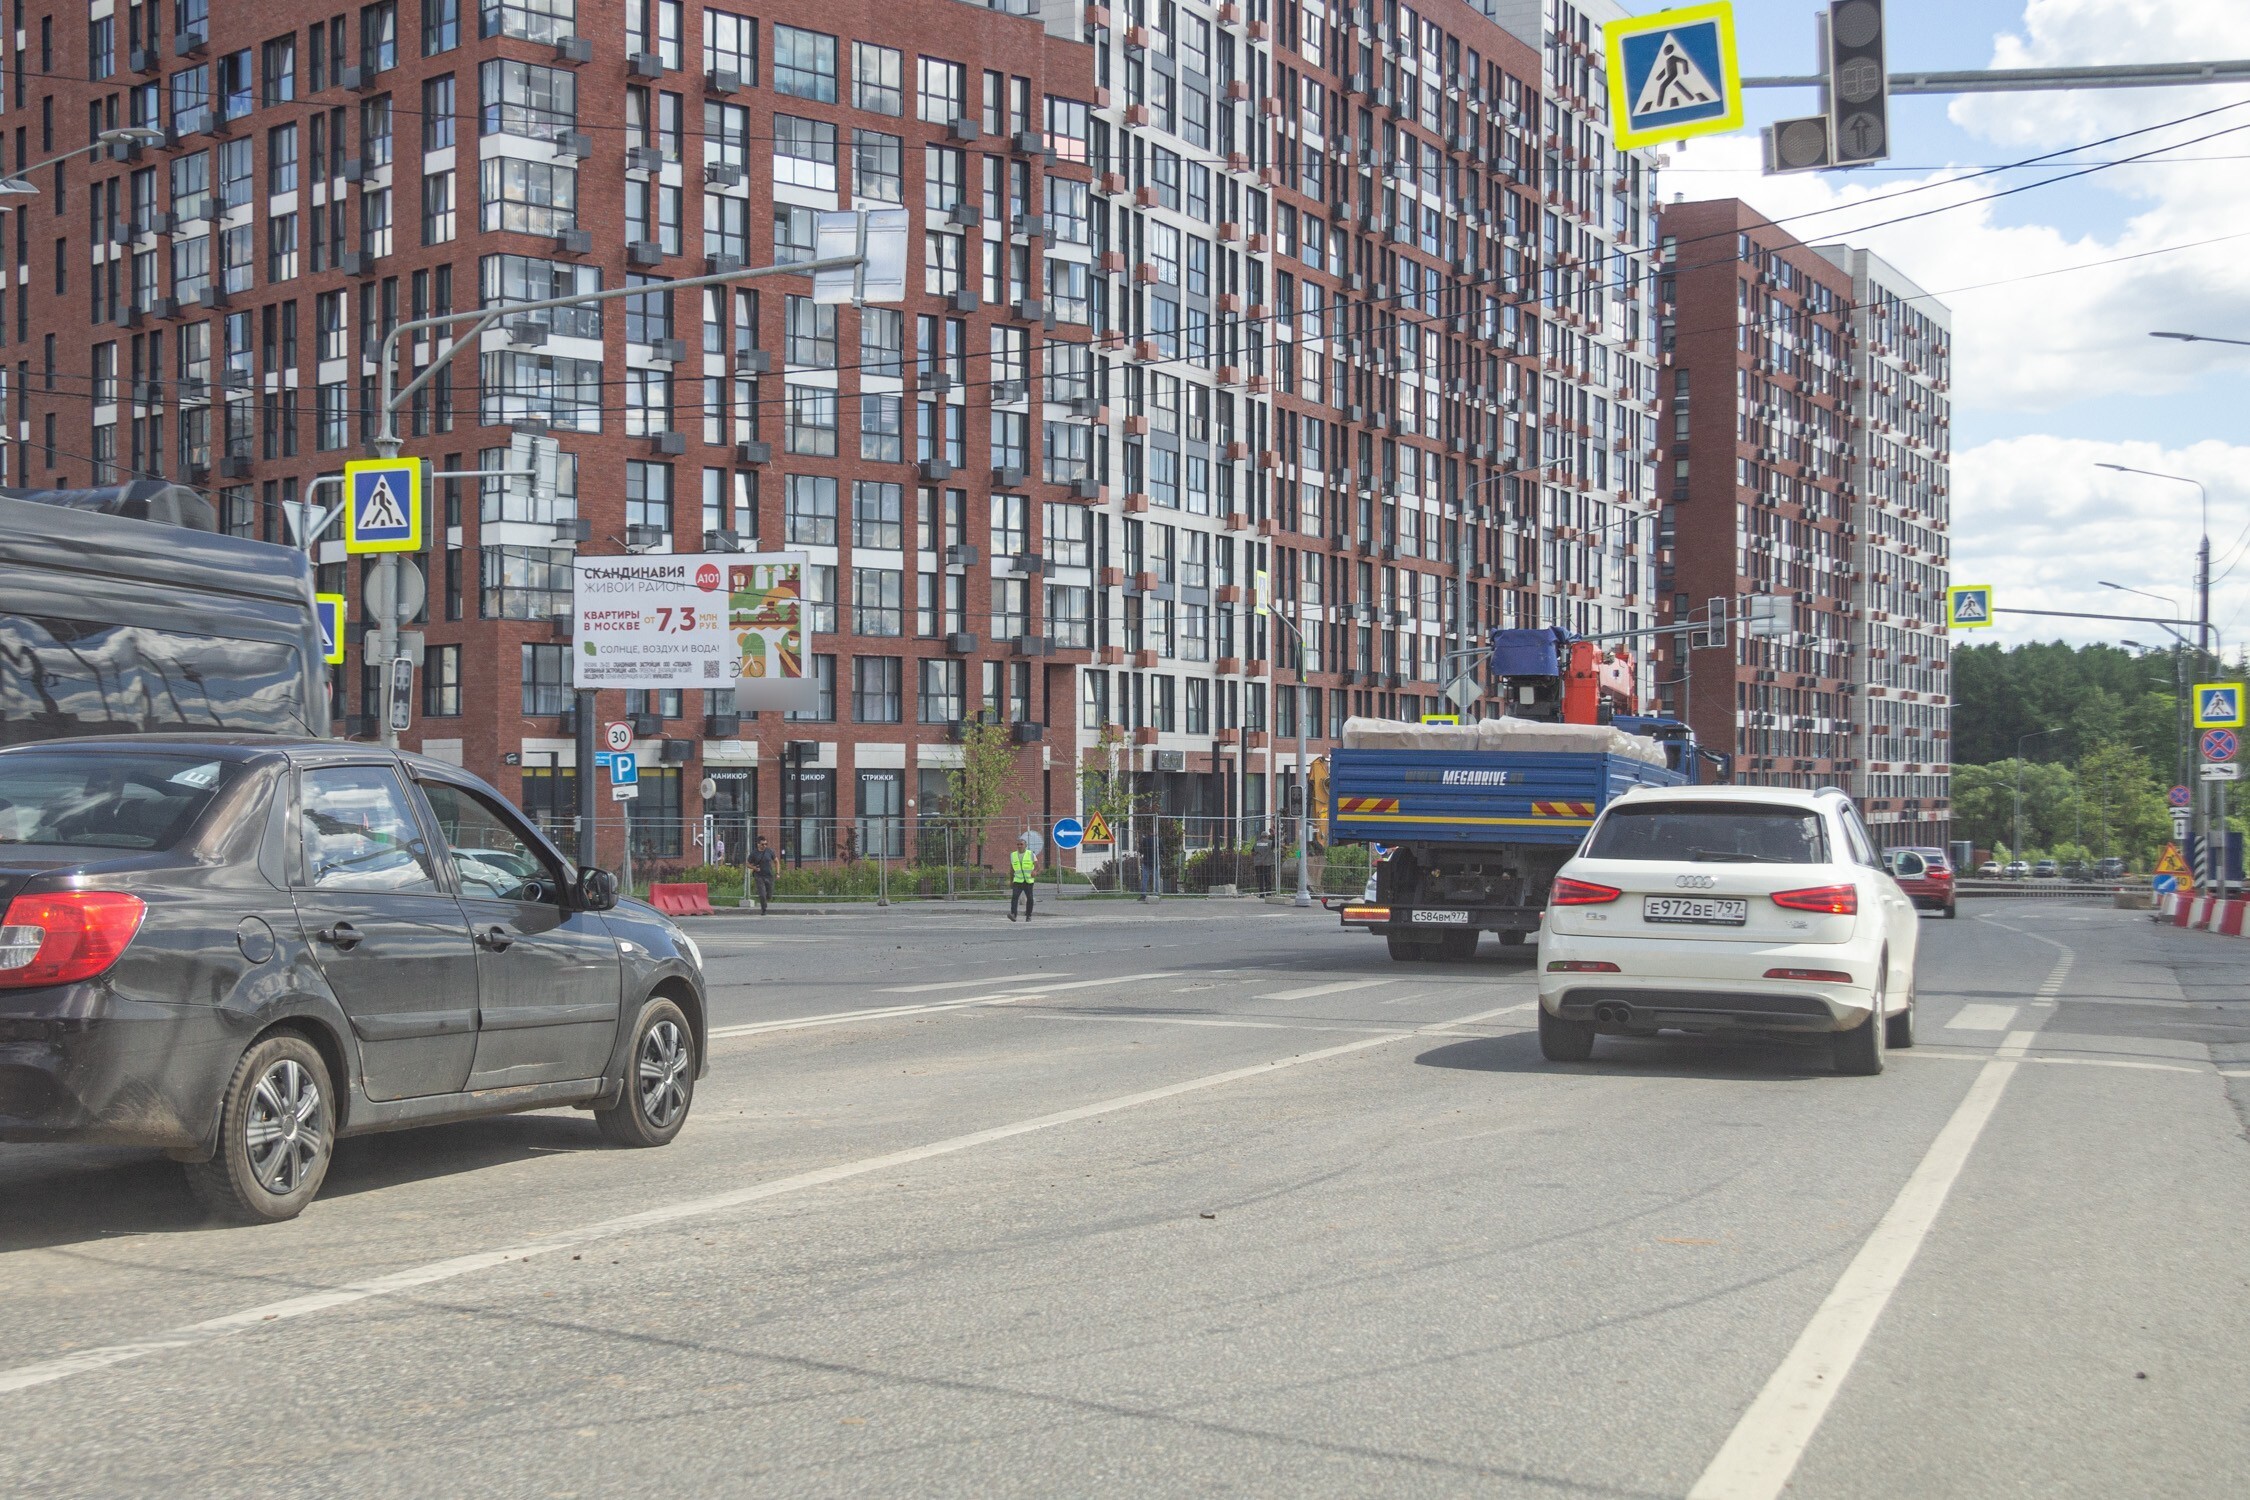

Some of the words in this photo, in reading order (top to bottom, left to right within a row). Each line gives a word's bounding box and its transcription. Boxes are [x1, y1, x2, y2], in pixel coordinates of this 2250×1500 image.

[584, 566, 685, 580] СКАНДИНАВИЯ
[584, 581, 634, 593] ЖИВОЙ
[638, 581, 686, 592] РАЙОН
[584, 611, 640, 620] КВАРТИРЫ
[656, 607, 697, 635] 7,3
[584, 622, 591, 631] В
[594, 622, 640, 631] МОСКВЕ
[600, 645, 641, 655] СОЛНЦЕ,
[643, 645, 680, 654] ВОЗДУХ
[682, 645, 689, 653] И
[691, 644, 720, 653] ВОДА!
[611, 731, 627, 743] 30
[711, 772, 748, 780] МАНИКЮР
[790, 773, 826, 781] ПДИКЮР
[1441, 770, 1507, 786] MEGADRIVE
[1716, 901, 1741, 913] 797
